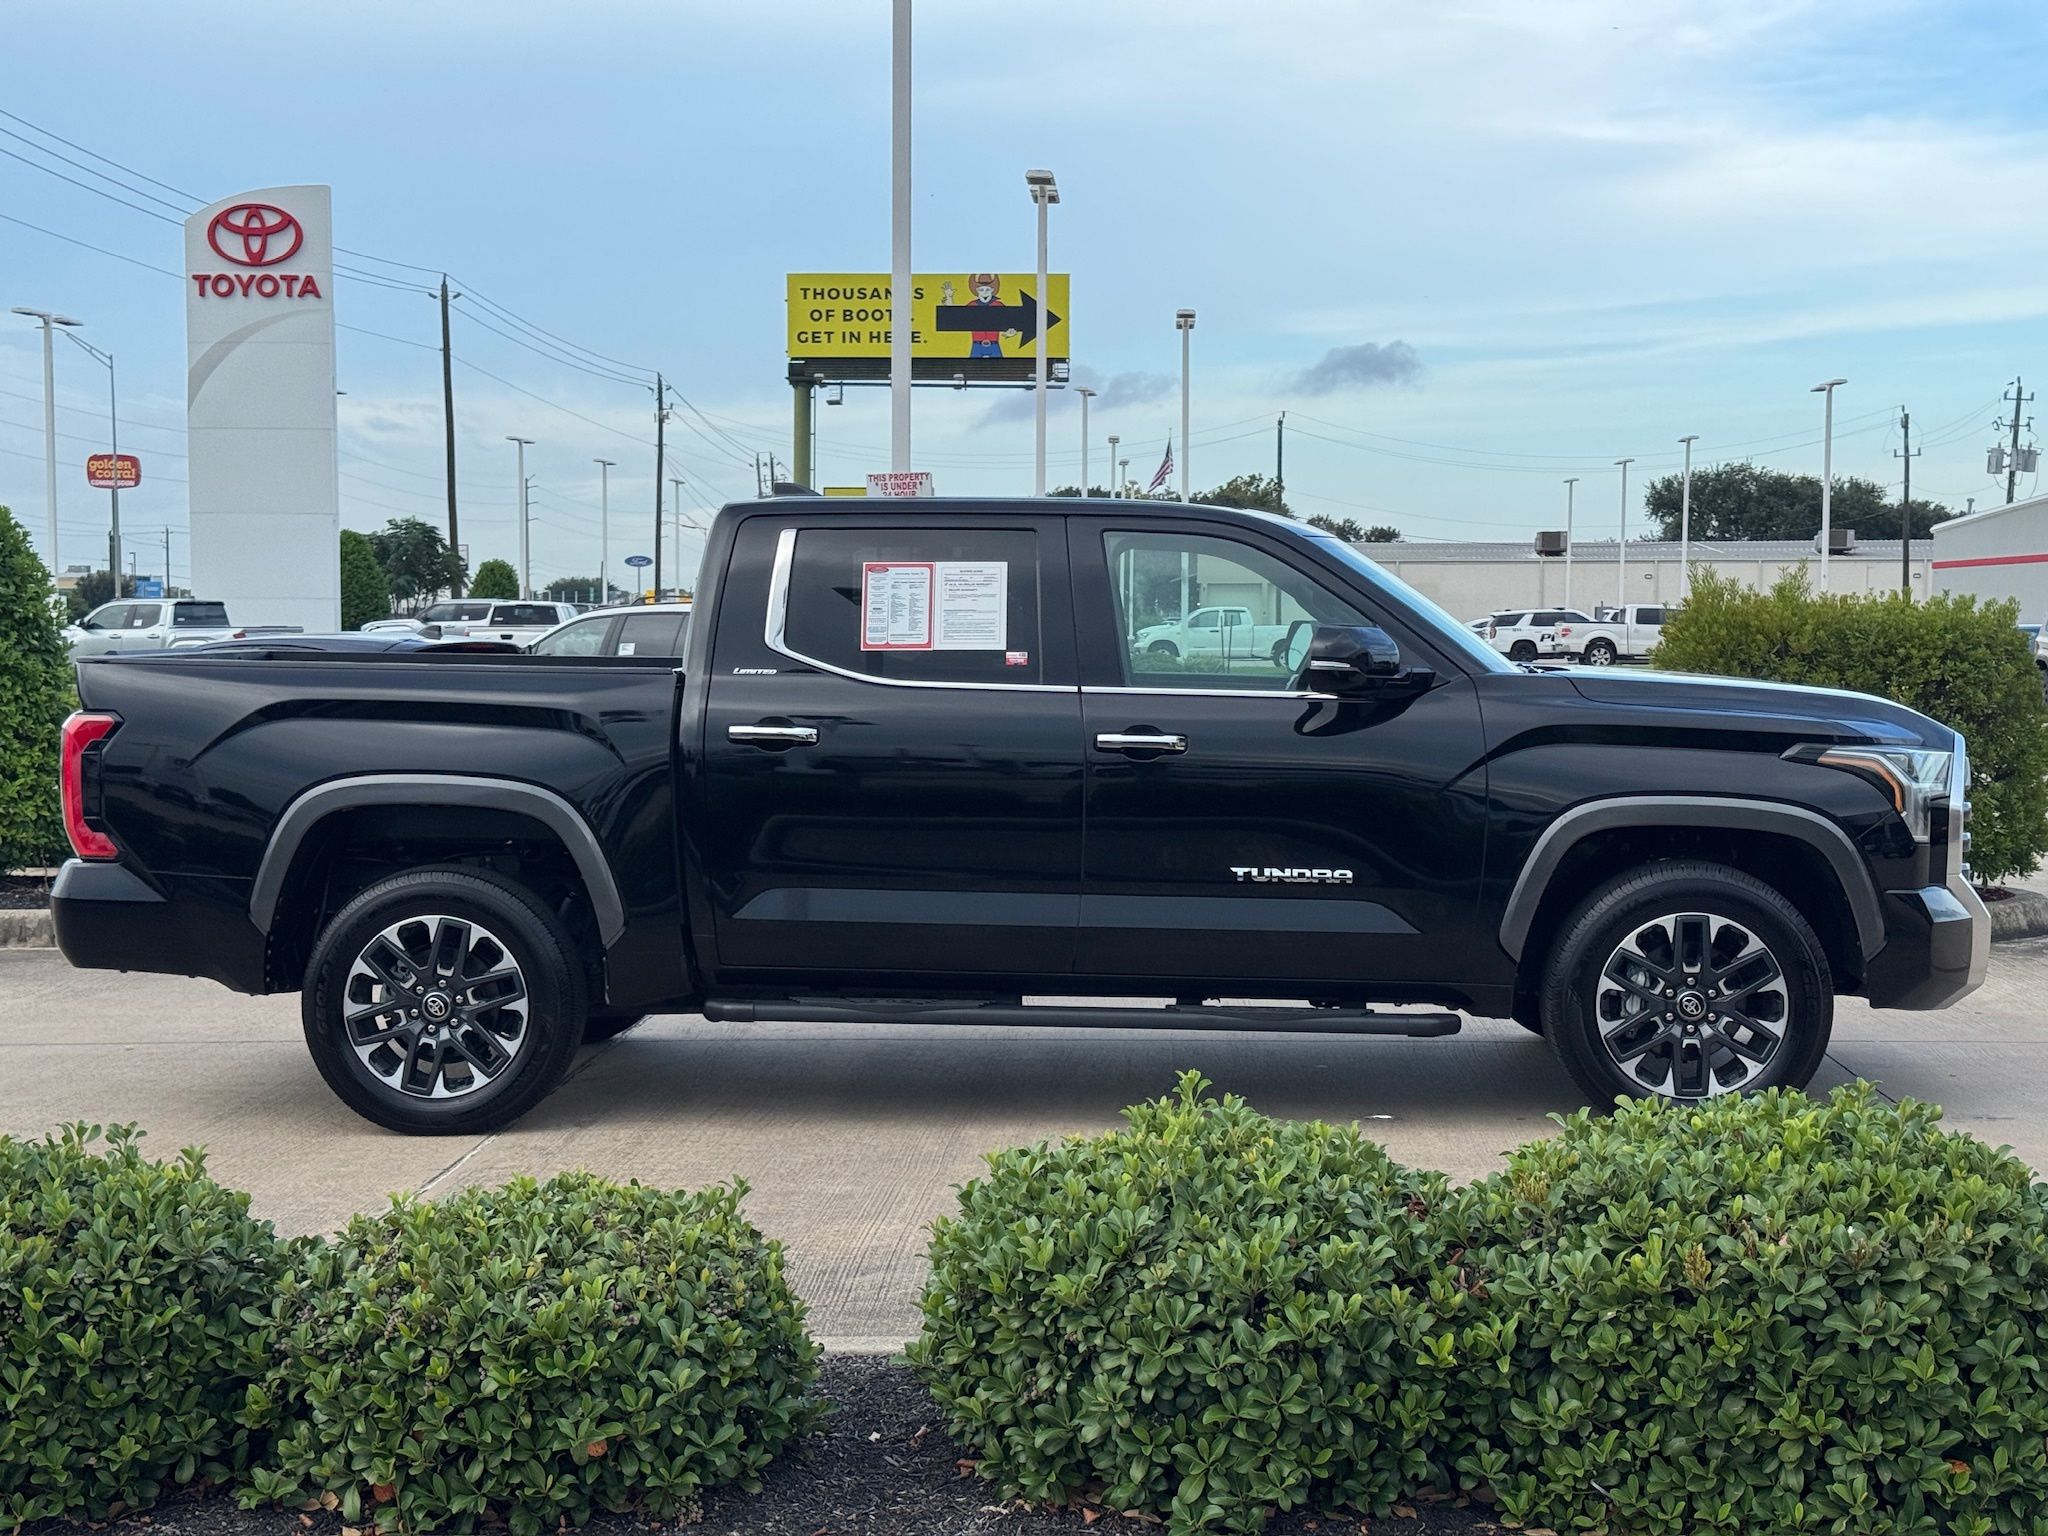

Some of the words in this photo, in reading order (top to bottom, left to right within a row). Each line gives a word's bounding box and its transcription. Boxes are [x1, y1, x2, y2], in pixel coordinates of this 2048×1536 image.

[192, 273, 322, 299] TOYOTA
[800, 287, 924, 300] THOUSANS
[809, 309, 835, 322] OF
[797, 331, 834, 343] GET
[842, 331, 861, 343] IN
[869, 331, 928, 343] HEE.
[868, 474, 886, 482] THIS
[889, 473, 929, 481] PROPERTY
[881, 483, 889, 491] IS
[891, 482, 918, 490] UNDER
[1230, 867, 1354, 884] TUNDRA
